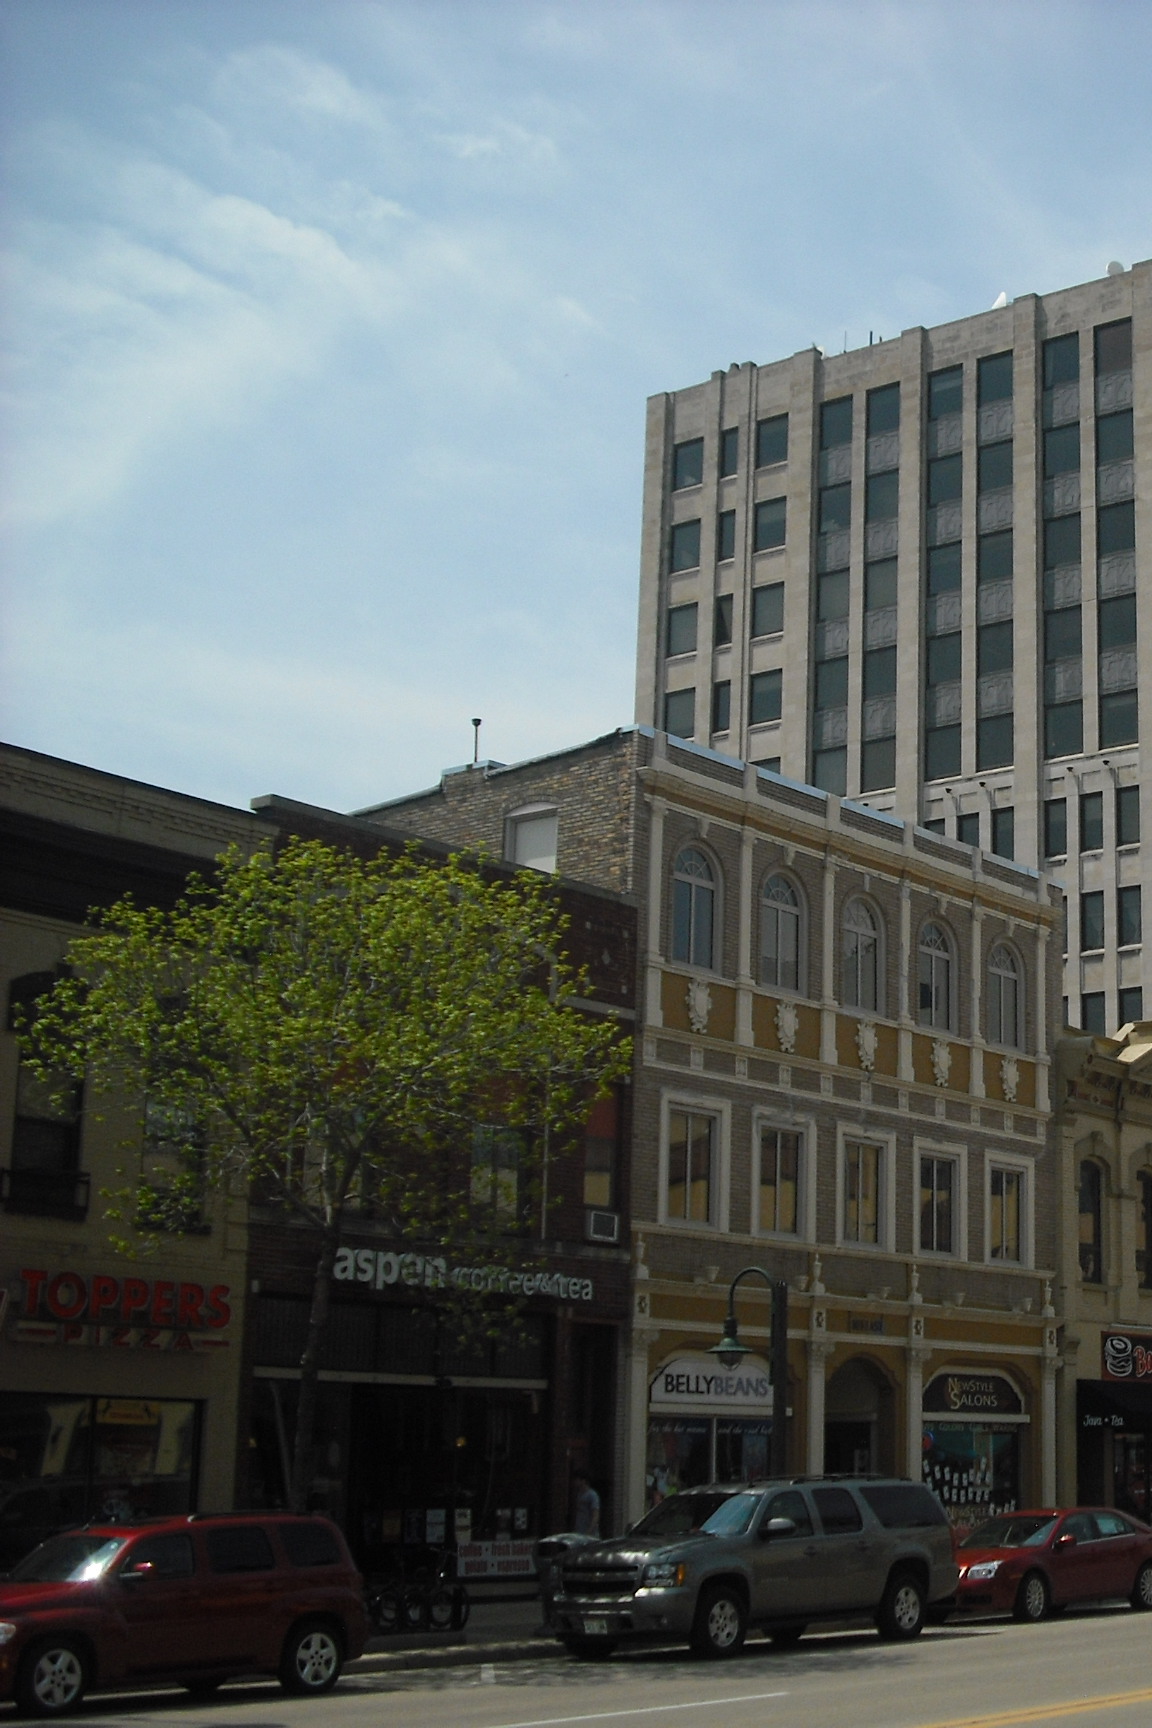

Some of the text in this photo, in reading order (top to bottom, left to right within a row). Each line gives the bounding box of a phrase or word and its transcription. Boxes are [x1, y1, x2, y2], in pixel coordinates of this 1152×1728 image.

[332, 1246, 447, 1290] aspen
[20, 1268, 231, 1328] TOPPERS
[64, 1323, 194, 1351] PIZZA
[664, 1374, 769, 1398] BELLYBEANS
[950, 1391, 998, 1410] SALONS
[1082, 1415, 1124, 1428] Java Tea
